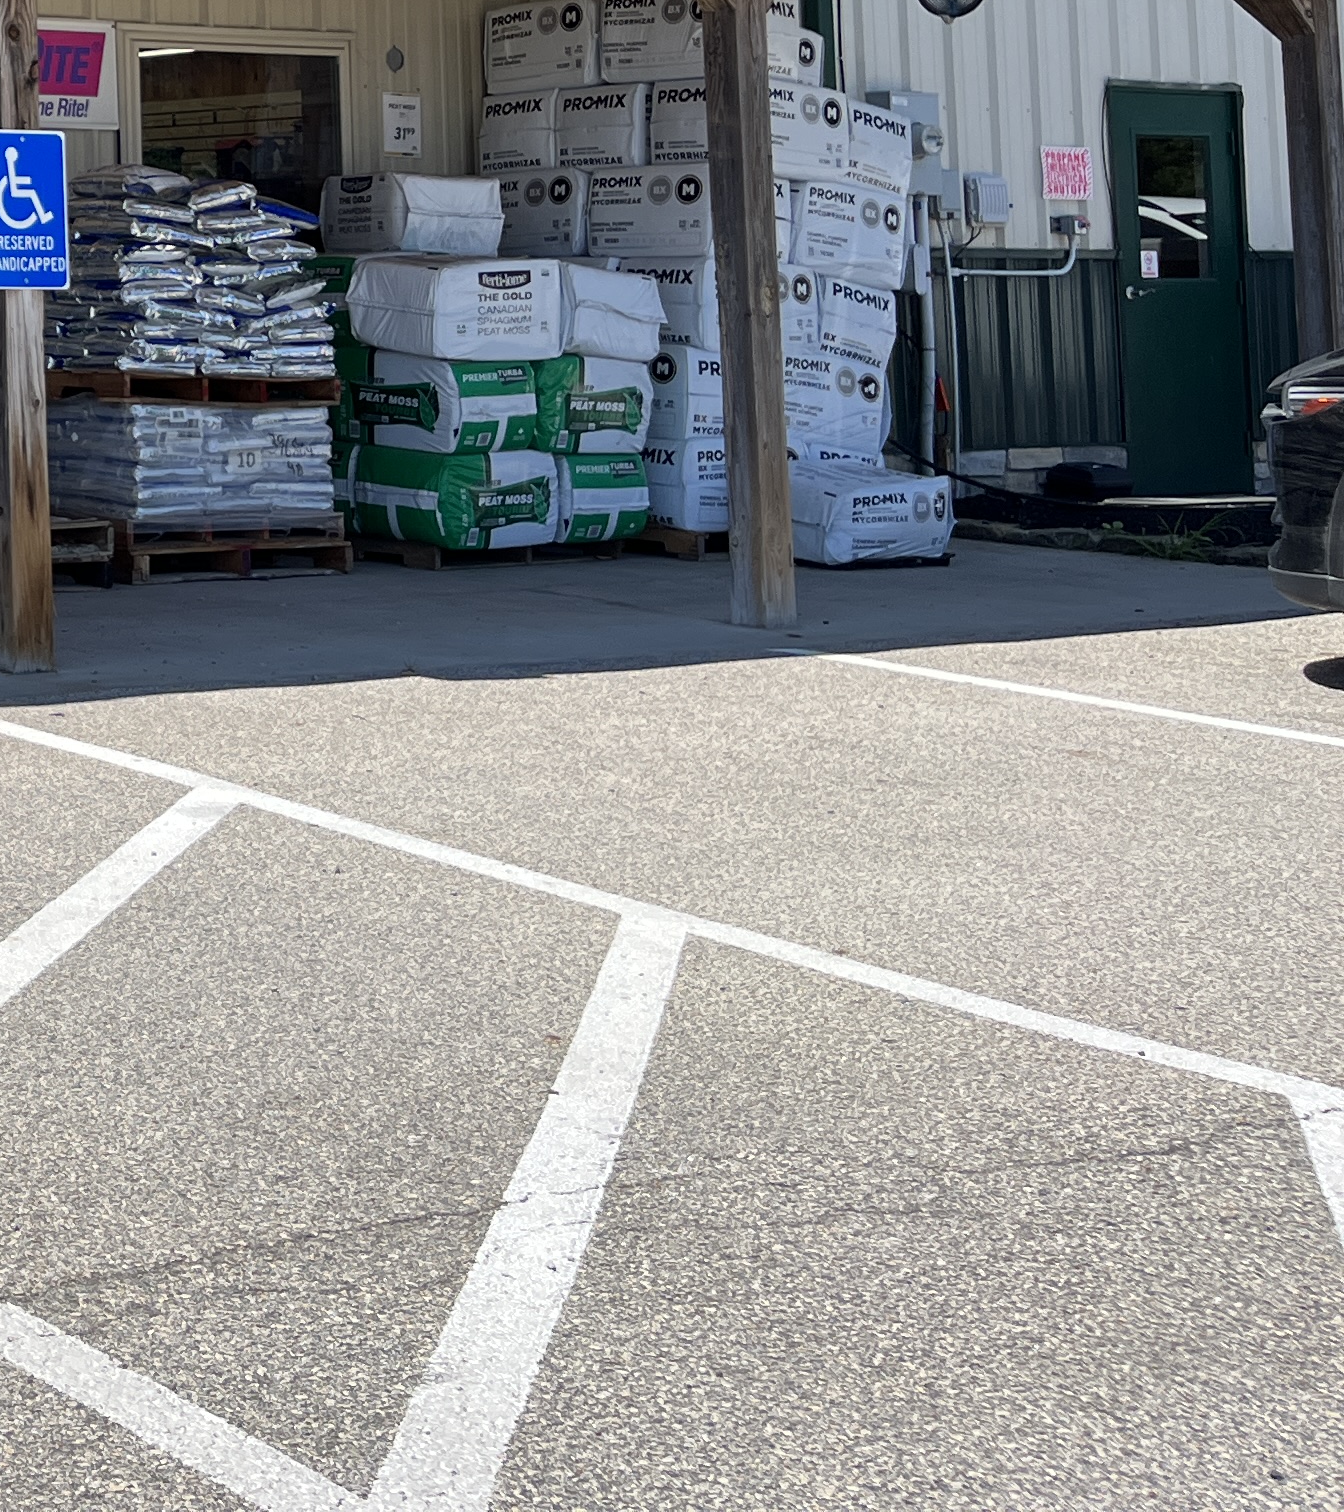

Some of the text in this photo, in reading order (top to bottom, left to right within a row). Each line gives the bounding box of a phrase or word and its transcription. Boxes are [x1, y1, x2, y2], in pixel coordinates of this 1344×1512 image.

[57, 97, 90, 118] Rite!
[1045, 151, 1087, 163] PROPANE
[1047, 184, 1088, 196] SHUTOFF
[477, 291, 533, 303] THE GOLD
[477, 304, 532, 316] CANADIAN
[476, 315, 532, 326] SPHAGNUM
[477, 326, 500, 336] PEAT
[502, 325, 531, 335] MOSS
[819, 344, 882, 369] MYCORRHIZAE
[462, 368, 523, 383] PREMIER TURBA
[358, 391, 419, 408] PEAT MOSS
[569, 400, 626, 412] PEAT MOSS
[237, 451, 256, 468] 10
[575, 464, 610, 475] PREMIER
[478, 494, 534, 507] PEAT MOSS
